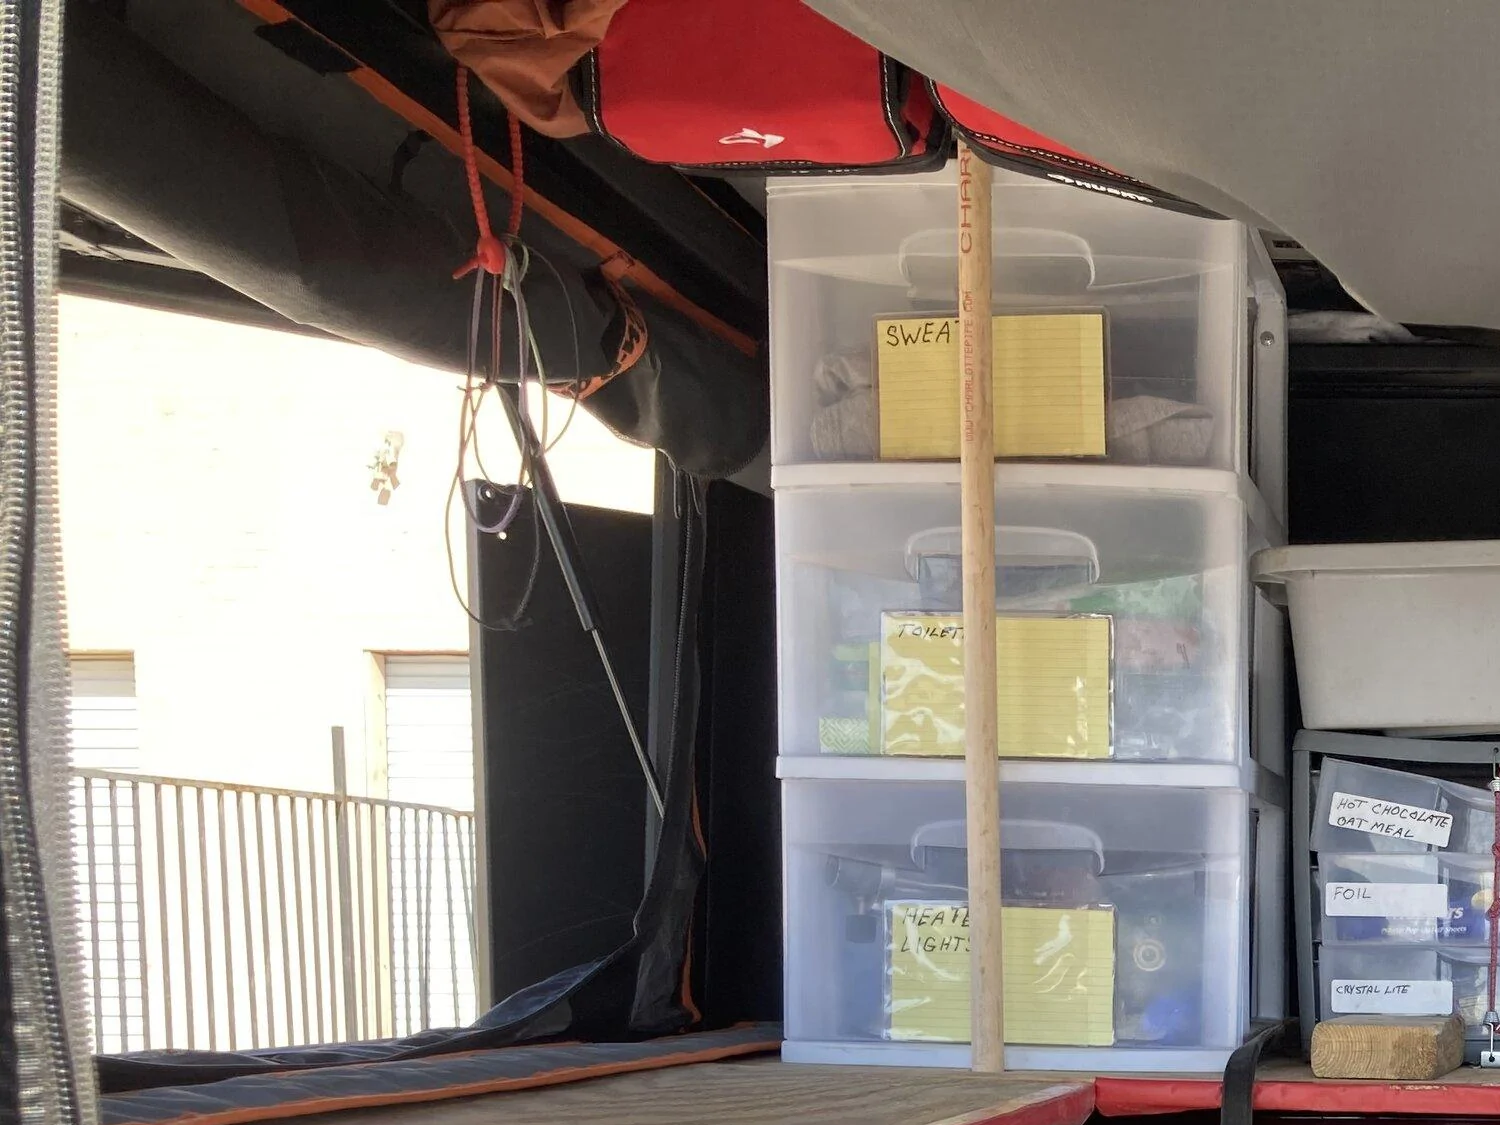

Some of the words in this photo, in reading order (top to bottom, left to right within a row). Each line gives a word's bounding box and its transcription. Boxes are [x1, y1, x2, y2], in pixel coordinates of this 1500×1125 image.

[959, 149, 973, 254] CHAR
[886, 320, 960, 347] SWEA
[1336, 799, 1367, 815] HOT
[1371, 803, 1450, 829] CHOCOLATE
[1337, 815, 1369, 830] OAT
[1372, 822, 1415, 839] MEAL
[1332, 886, 1372, 901] FOIL
[1335, 984, 1381, 996] CRYSTAL
[1384, 984, 1412, 996] LITE
